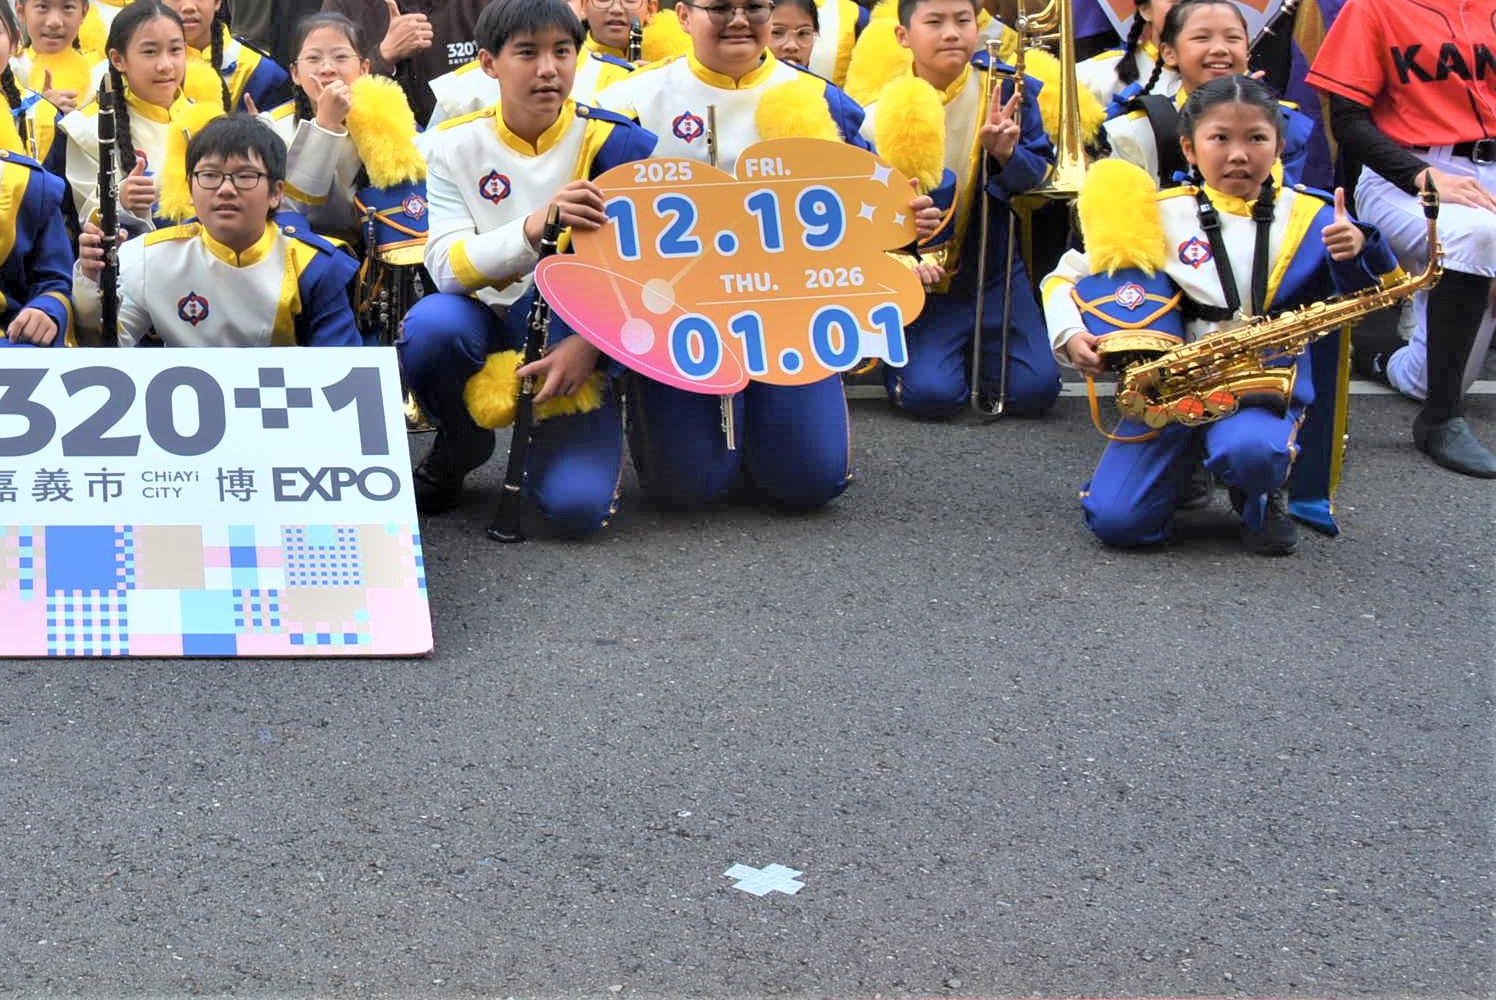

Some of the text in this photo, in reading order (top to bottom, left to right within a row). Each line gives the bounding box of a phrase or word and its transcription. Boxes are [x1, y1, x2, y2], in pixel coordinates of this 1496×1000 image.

[634, 157, 792, 183] 2025 FRI.
[604, 184, 847, 261] 12.19
[720, 267, 865, 294] THU. 2026
[668, 302, 908, 381] 01.01
[216, 466, 402, 502] 博 EXPO
